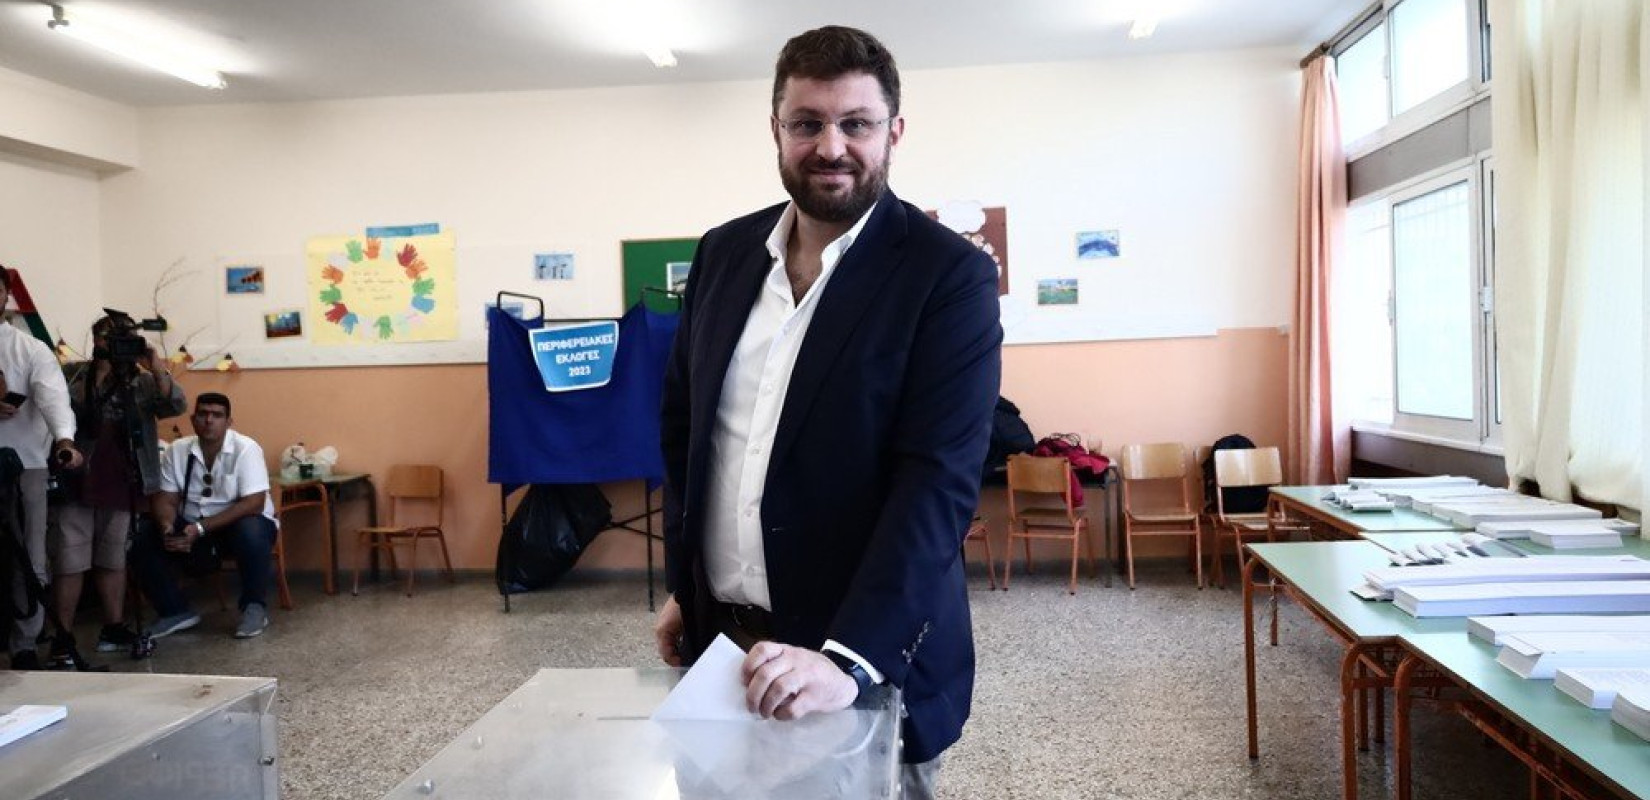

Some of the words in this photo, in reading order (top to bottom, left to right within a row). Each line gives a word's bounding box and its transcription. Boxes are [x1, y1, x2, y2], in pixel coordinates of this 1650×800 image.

[537, 333, 614, 352] ΠΕΡΙΦΕΡΕΙΑΚΕΣ
[555, 349, 600, 365] ΕΚΛΟΓΕΣ
[568, 365, 592, 377] 2023
